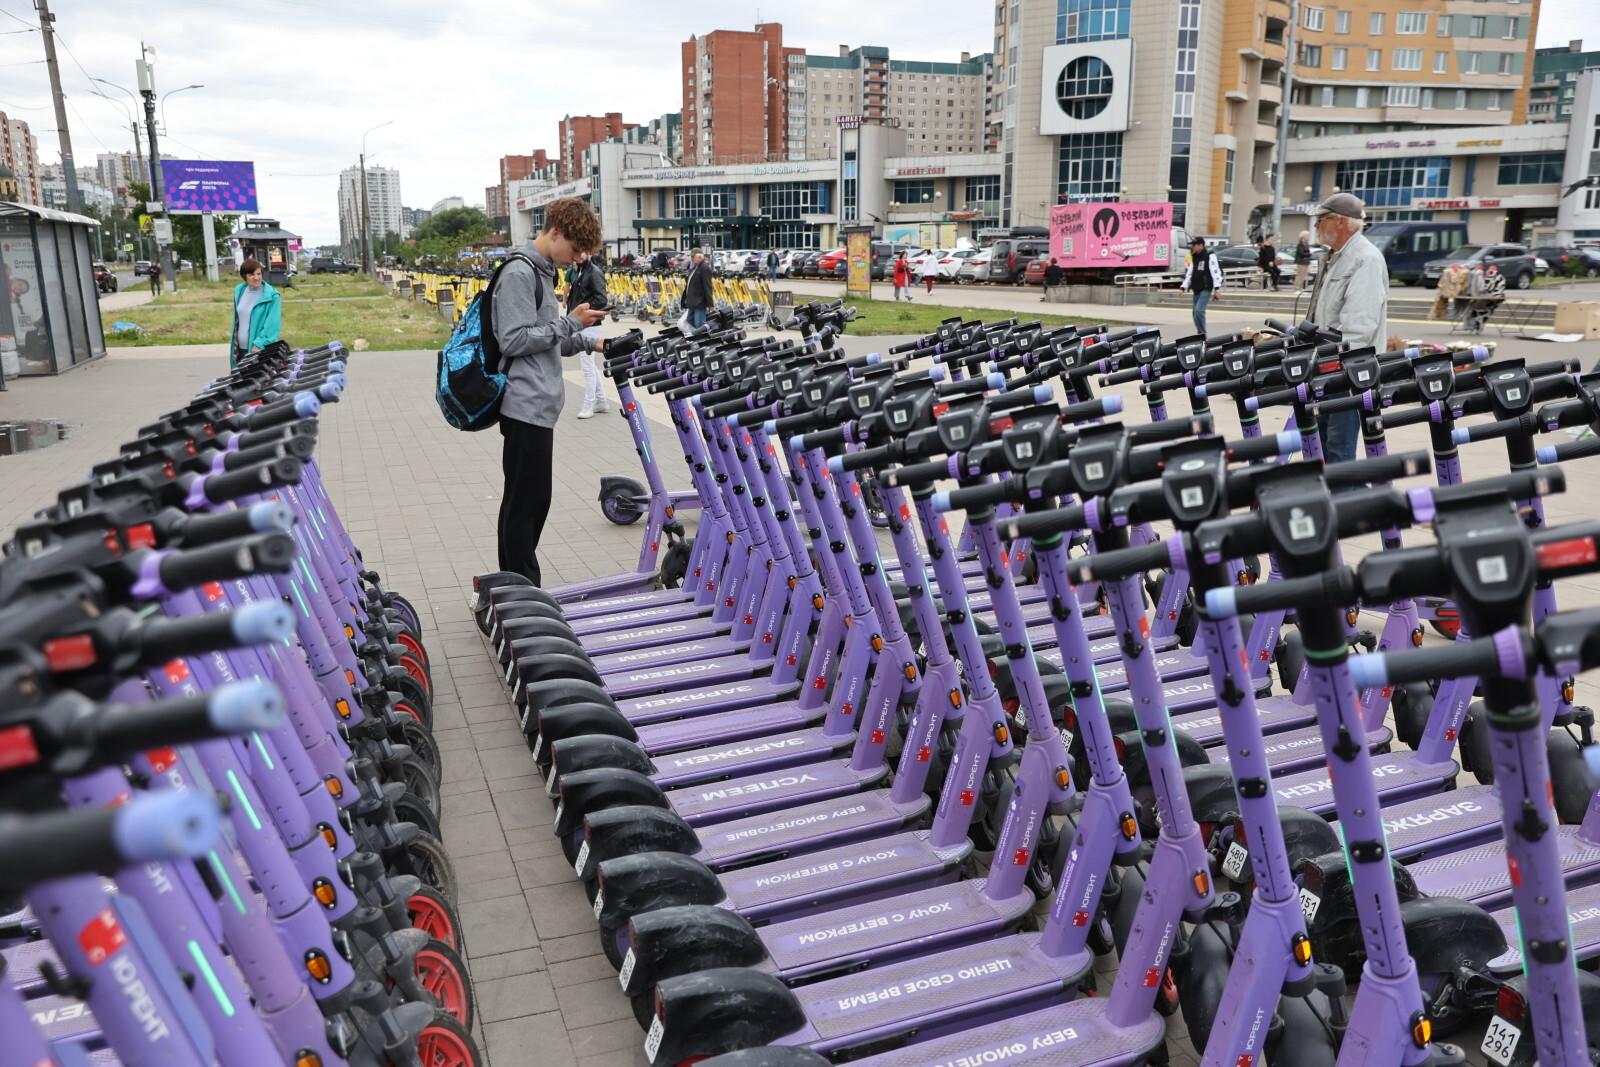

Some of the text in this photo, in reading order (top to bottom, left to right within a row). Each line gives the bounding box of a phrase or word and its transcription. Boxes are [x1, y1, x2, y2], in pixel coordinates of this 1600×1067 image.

[1426, 200, 1469, 209] АПТЕКА
[1134, 220, 1168, 232] КРОЛИК
[619, 643, 705, 662] УСПЕЕМ
[630, 663, 721, 682] УСПЕЕМ
[635, 685, 753, 710] ЗАРЯЖЕН
[878, 697, 891, 730] ЮРЕНТ
[924, 713, 938, 748] ЮРЕНТ
[675, 737, 806, 767] ЗАРЯЖЕН
[967, 752, 982, 790] ЮРЕНТ
[702, 774, 818, 801] УСПЕЕМ
[726, 805, 866, 842] БЕРУ ФИОЛЕТОВЫЕ
[1022, 808, 1037, 848] ЮРЕНТ
[1385, 801, 1483, 834] ЗАРЯЖ
[756, 849, 899, 888] ХОЧУ С ВЕТЕРКОМ
[1226, 858, 1241, 873] 412
[1230, 847, 1245, 861] 480
[1081, 873, 1097, 909] ЮРЕНТ
[1300, 894, 1317, 910] 151
[799, 901, 953, 946] ХОЧУ С ВЕТЕРКОМ
[1154, 920, 1173, 967] ЮРЕНТ
[112, 954, 170, 1042] ЮРЕНТ
[838, 958, 1013, 1011] ЦЕНЮ СВОЕ ВРЕМЯ
[1032, 1027, 1078, 1050] БЕРУ
[1245, 1007, 1265, 1051] ЮРЕНТ
[1491, 1022, 1516, 1046] 141
[1484, 1035, 1509, 1059] 296
